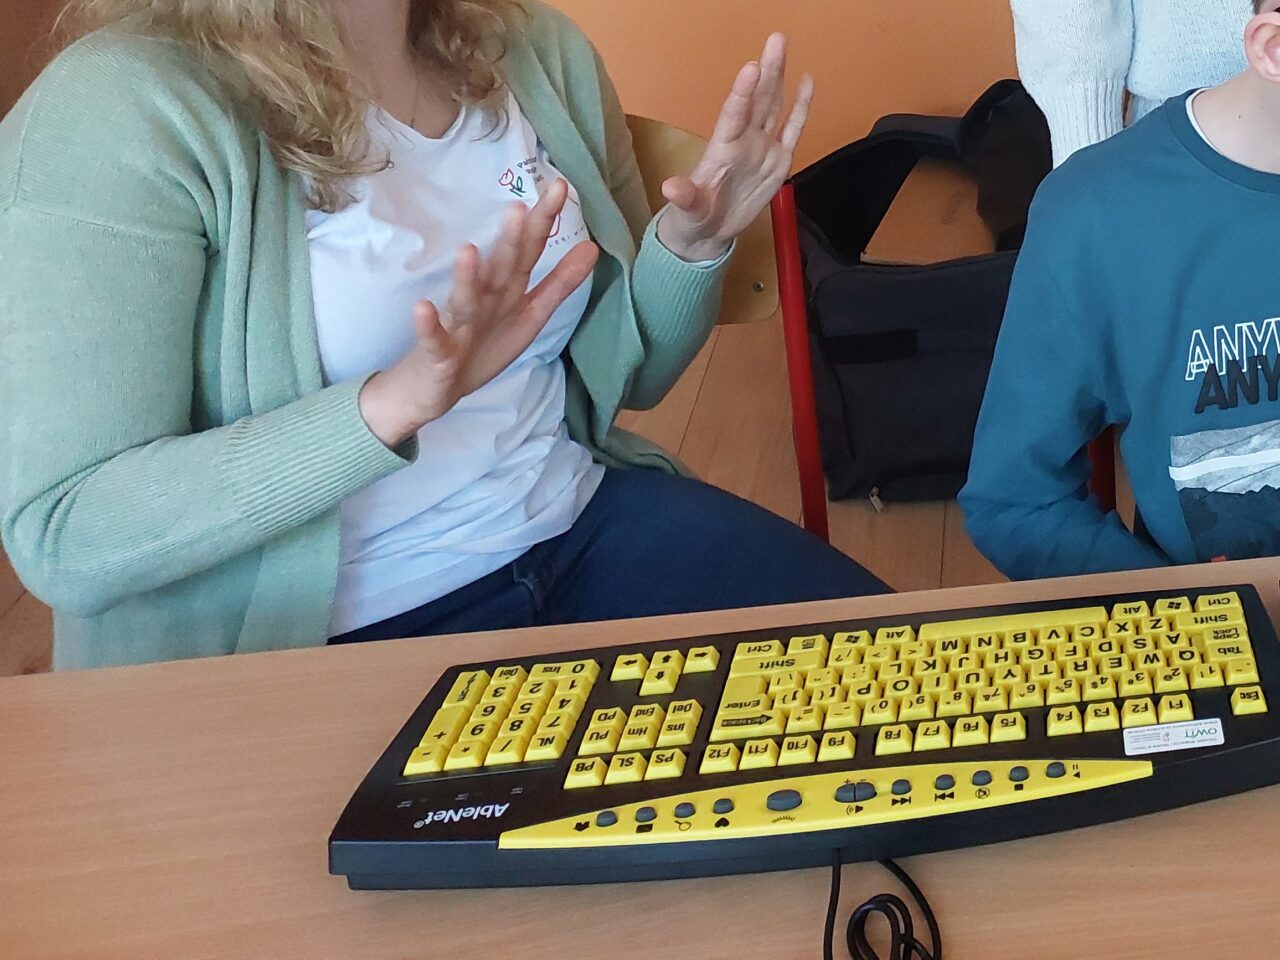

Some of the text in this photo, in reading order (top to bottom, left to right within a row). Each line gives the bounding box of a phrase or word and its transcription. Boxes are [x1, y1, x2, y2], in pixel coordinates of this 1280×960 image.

[1208, 598, 1231, 607] Ctrl
[1122, 606, 1142, 615] Alt
[1193, 614, 1229, 624] Shift
[747, 644, 772, 654] Ctrl
[1217, 646, 1244, 655] Tab
[759, 659, 796, 669] Shift
[1239, 691, 1260, 700] Esc
[672, 704, 693, 714] Del
[724, 700, 761, 710] Enter
[1131, 703, 1149, 713] F2
[1169, 699, 1184, 710] F1
[635, 707, 656, 718] End
[1056, 712, 1073, 721] F4
[1093, 707, 1110, 717] F3
[963, 722, 979, 732] F6
[1001, 718, 1017, 727] F5
[666, 723, 685, 733] Ins
[923, 726, 941, 736] F7
[588, 731, 609, 742] PU
[885, 730, 901, 739] F8
[787, 739, 809, 750] F10
[828, 736, 845, 746] F9
[709, 748, 731, 759] F12
[748, 744, 769, 754] F11
[618, 757, 635, 767] SL
[655, 753, 676, 763] PS
[576, 761, 596, 772] PB
